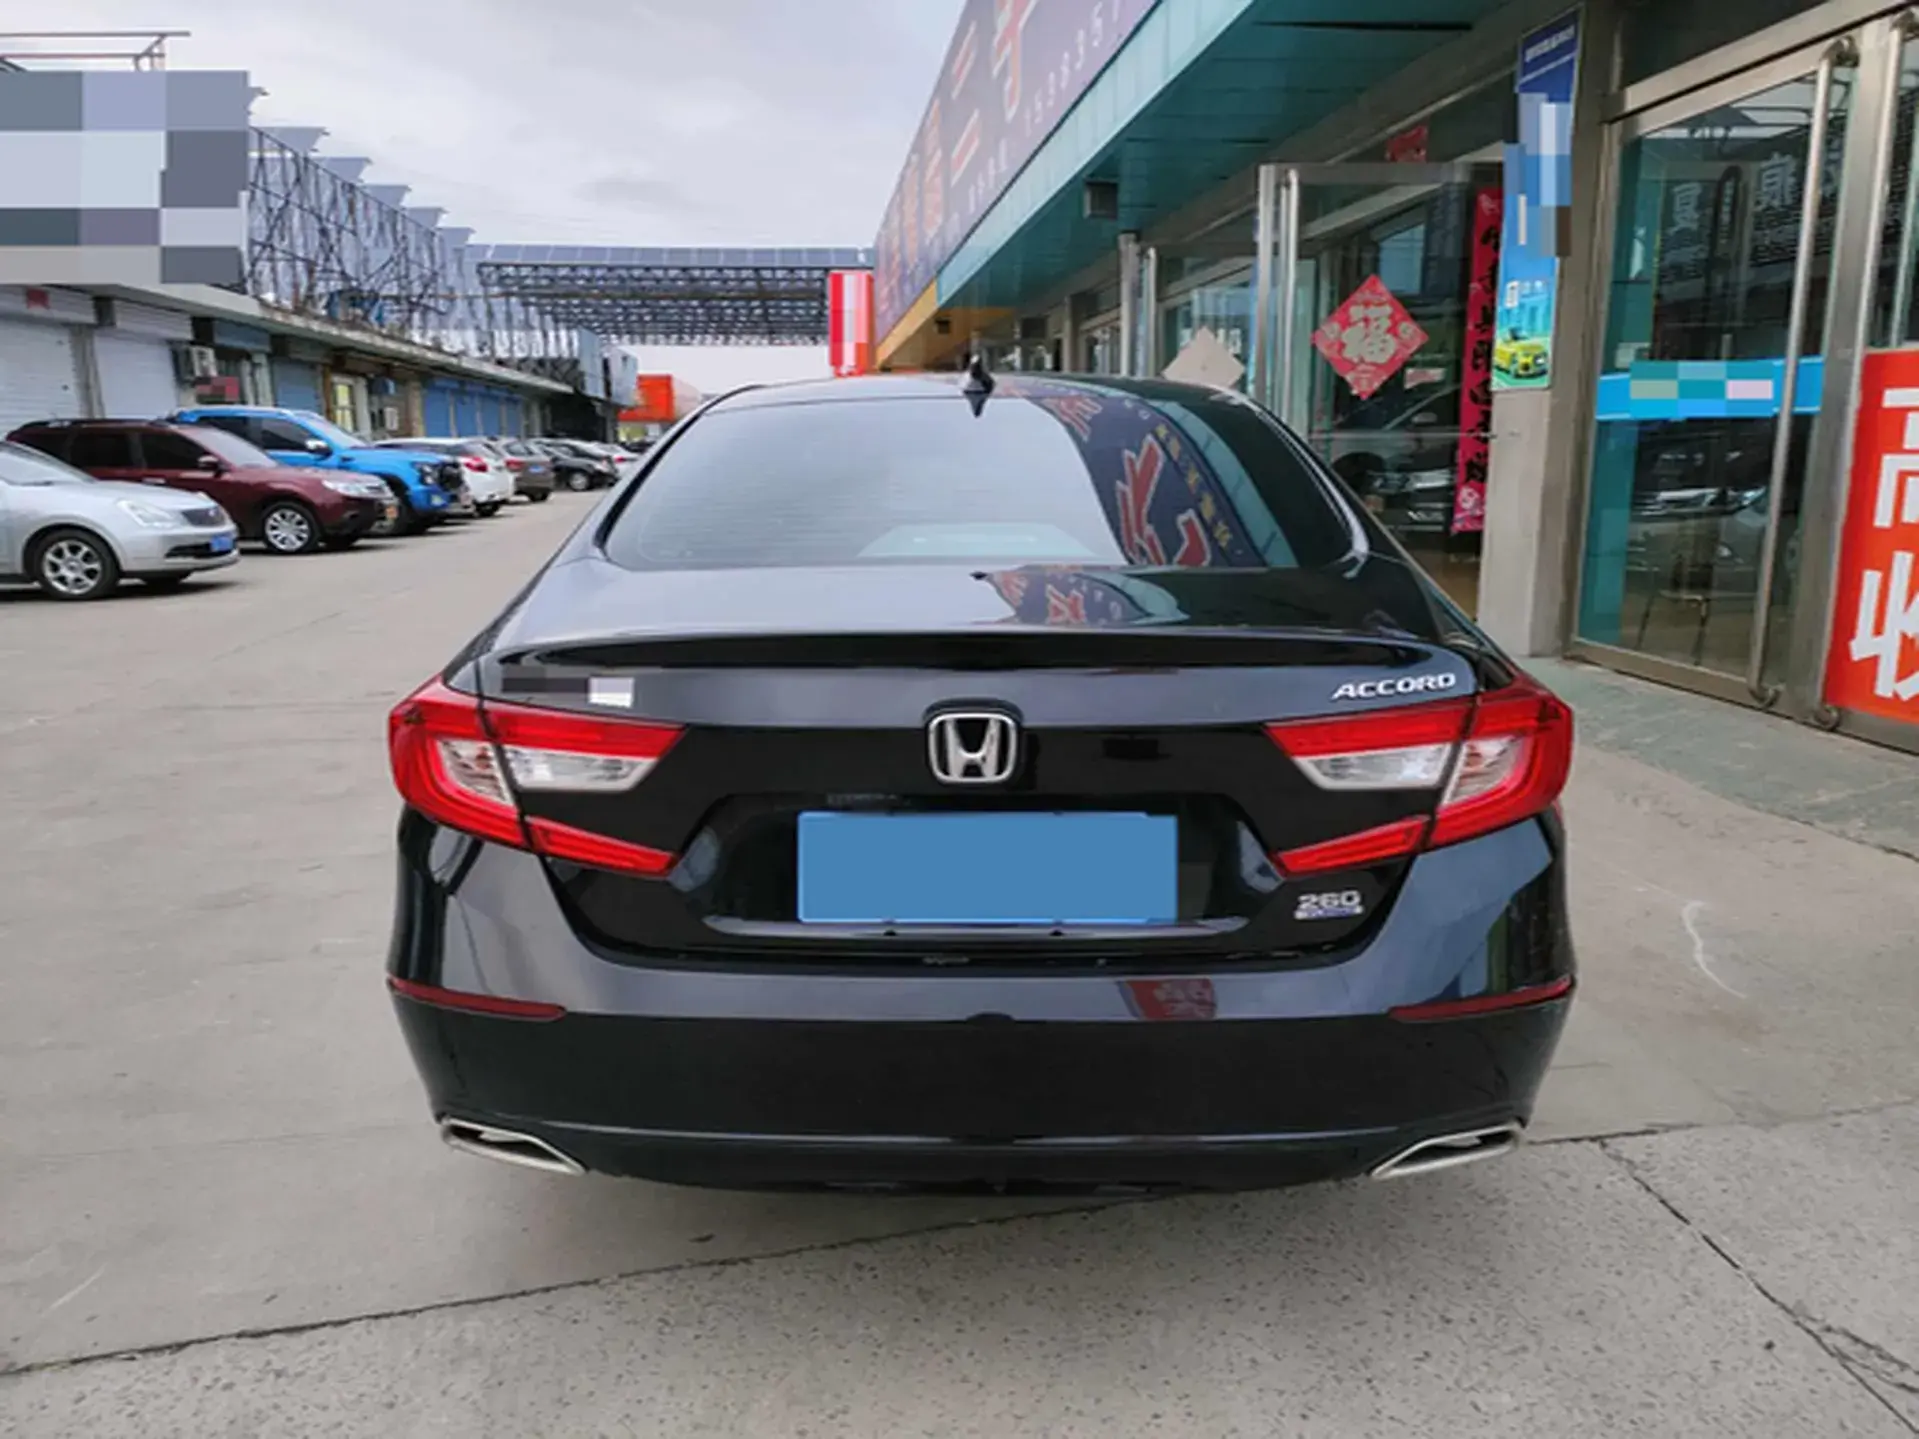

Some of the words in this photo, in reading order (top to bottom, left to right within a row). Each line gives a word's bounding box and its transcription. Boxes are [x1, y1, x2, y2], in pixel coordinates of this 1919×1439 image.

[1340, 304, 1398, 365] 福
[1330, 671, 1457, 701] ACCORD
[1296, 889, 1362, 910] 260
